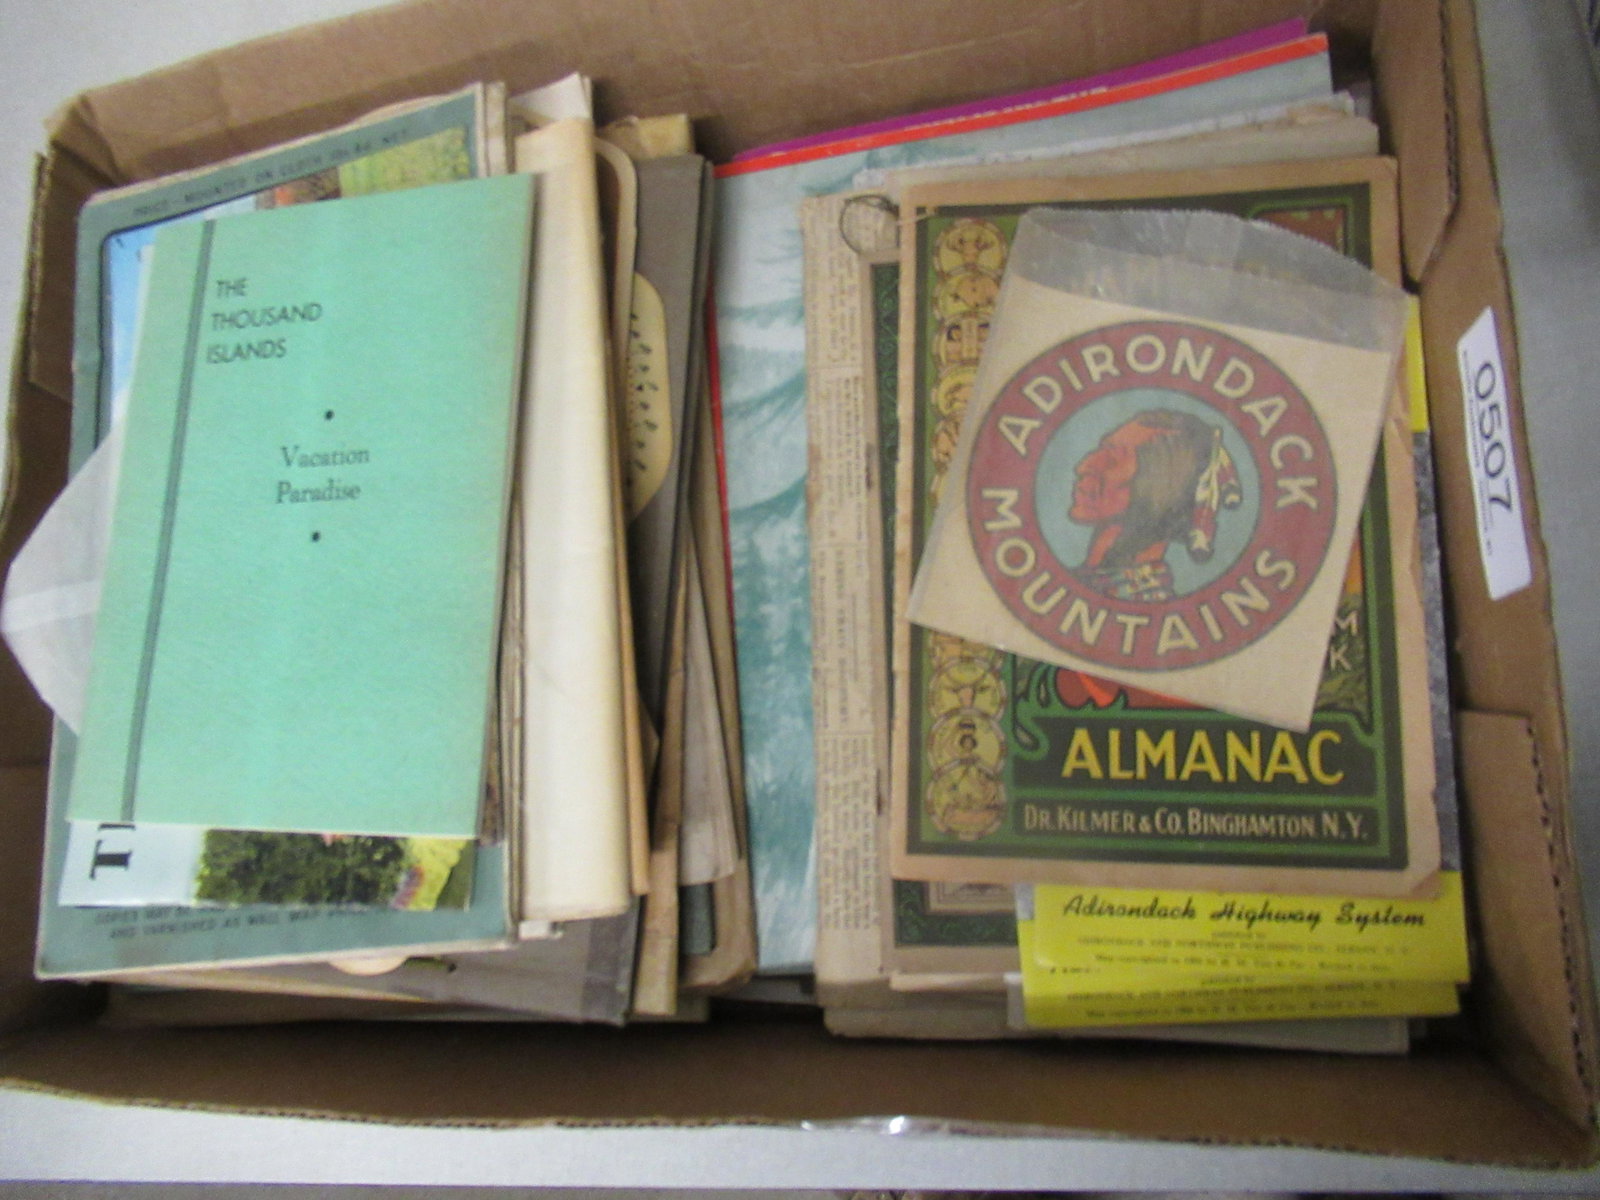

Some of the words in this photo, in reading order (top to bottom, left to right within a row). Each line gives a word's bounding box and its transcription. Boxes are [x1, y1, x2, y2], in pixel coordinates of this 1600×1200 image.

[217, 277, 246, 298] THE
[212, 302, 323, 331] THOUSAND
[206, 338, 286, 364] ISLANDS
[998, 334, 1318, 510] ADIRONDACK
[1474, 362, 1512, 512] 0507
[281, 444, 369, 468] Vacation
[276, 478, 362, 504] Paradise
[982, 487, 1296, 656] MOUNTAINS
[1061, 728, 1344, 785] ALMANAC
[1058, 806, 1135, 833] KILMER
[1187, 807, 1317, 838] BINGHAMTON
[1063, 894, 1197, 920] Adirondack
[1210, 899, 1322, 932] Highway
[1336, 901, 1425, 933] System
